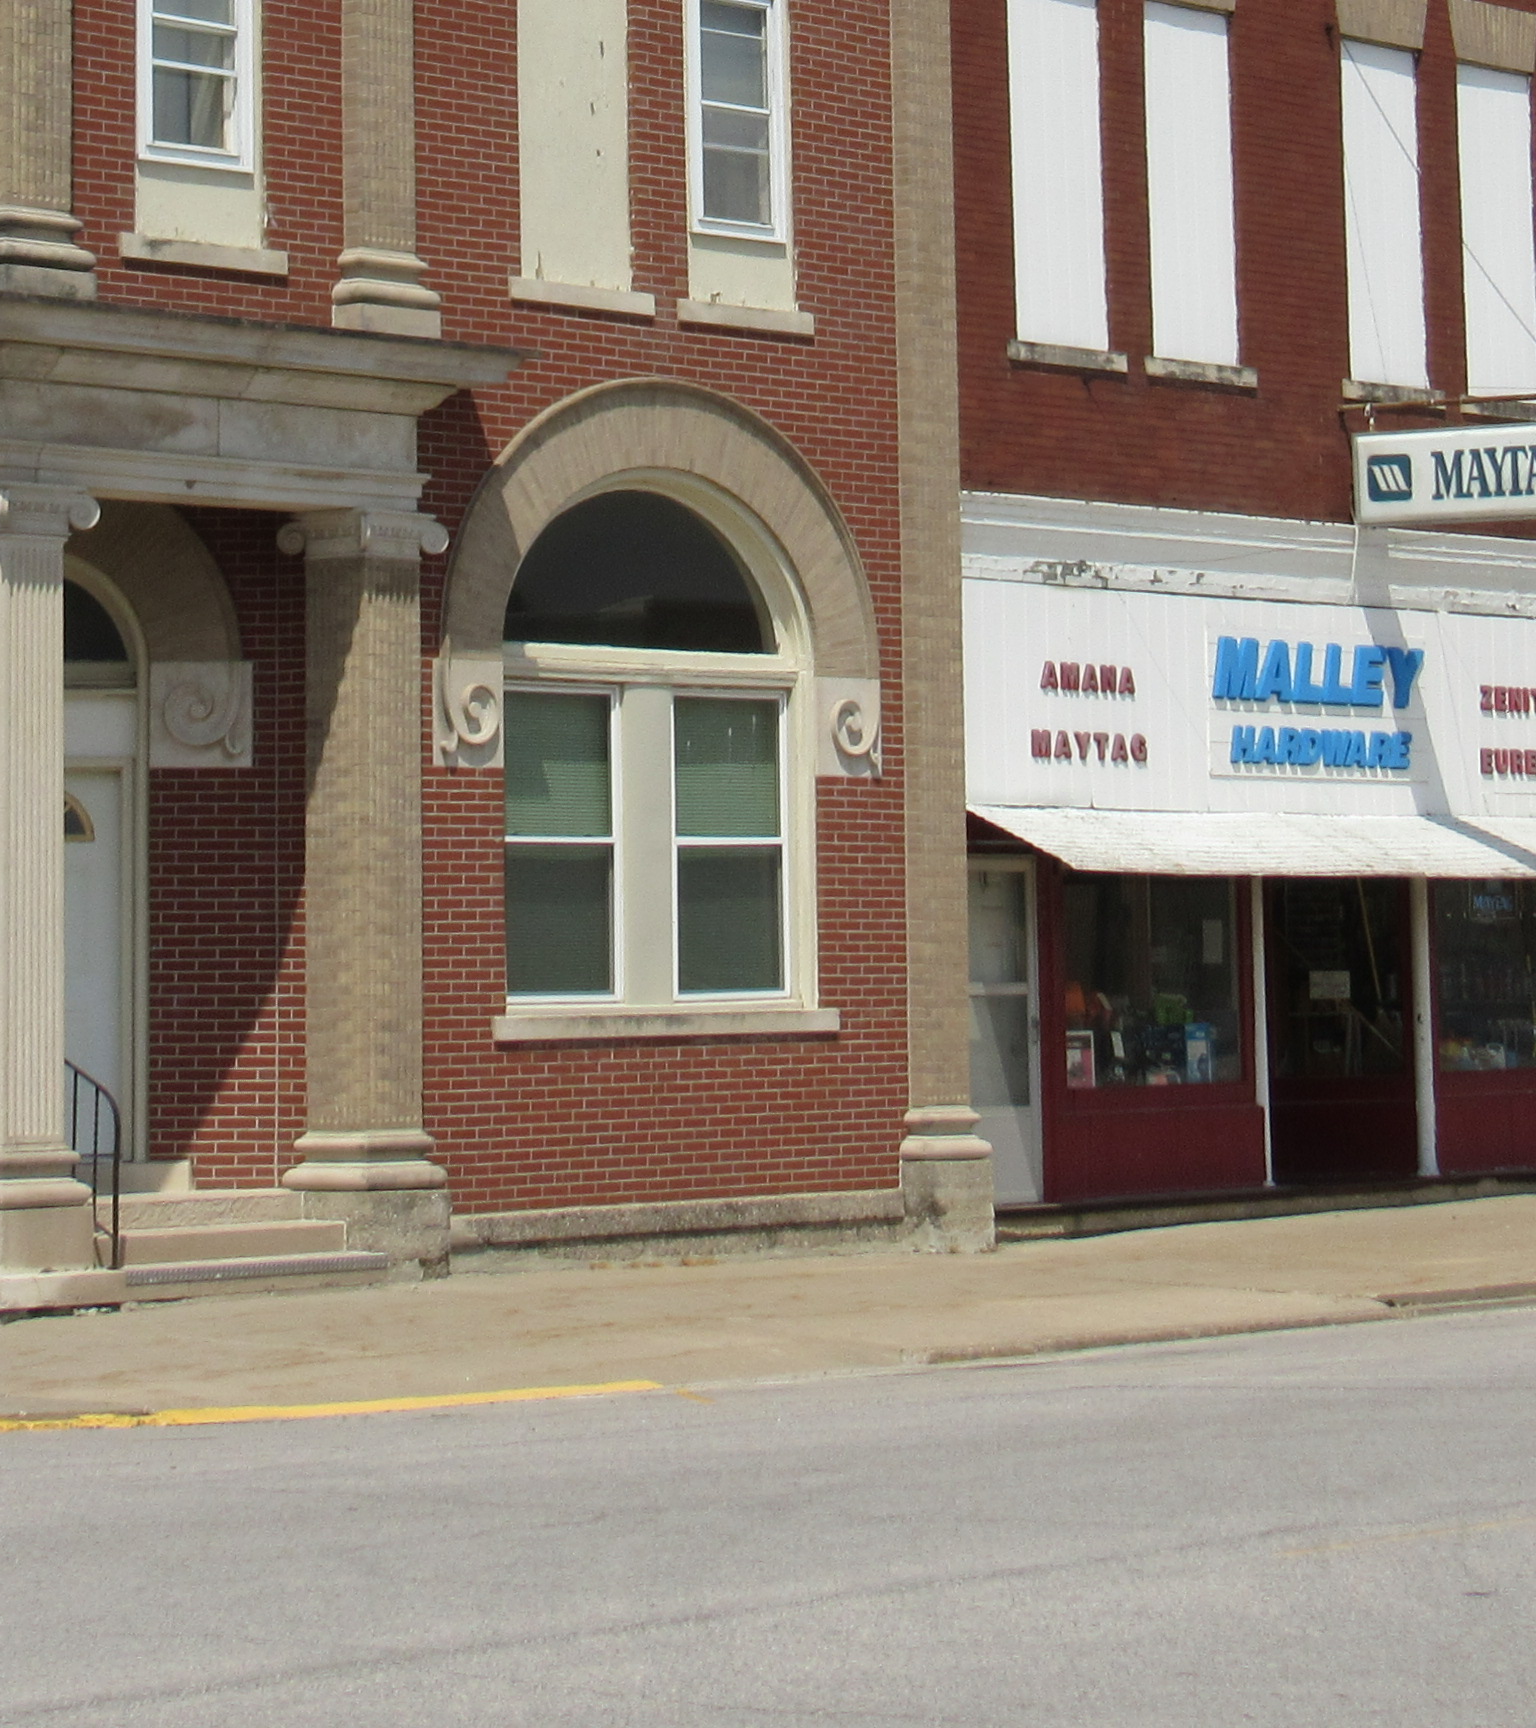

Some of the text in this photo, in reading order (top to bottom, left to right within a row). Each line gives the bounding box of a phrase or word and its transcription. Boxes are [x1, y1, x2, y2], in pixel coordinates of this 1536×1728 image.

[1040, 660, 1136, 694] AMANA
[1212, 635, 1425, 709] MALLEY
[1031, 728, 1148, 762] MAYTAG
[1230, 724, 1413, 771] HARDWARE
